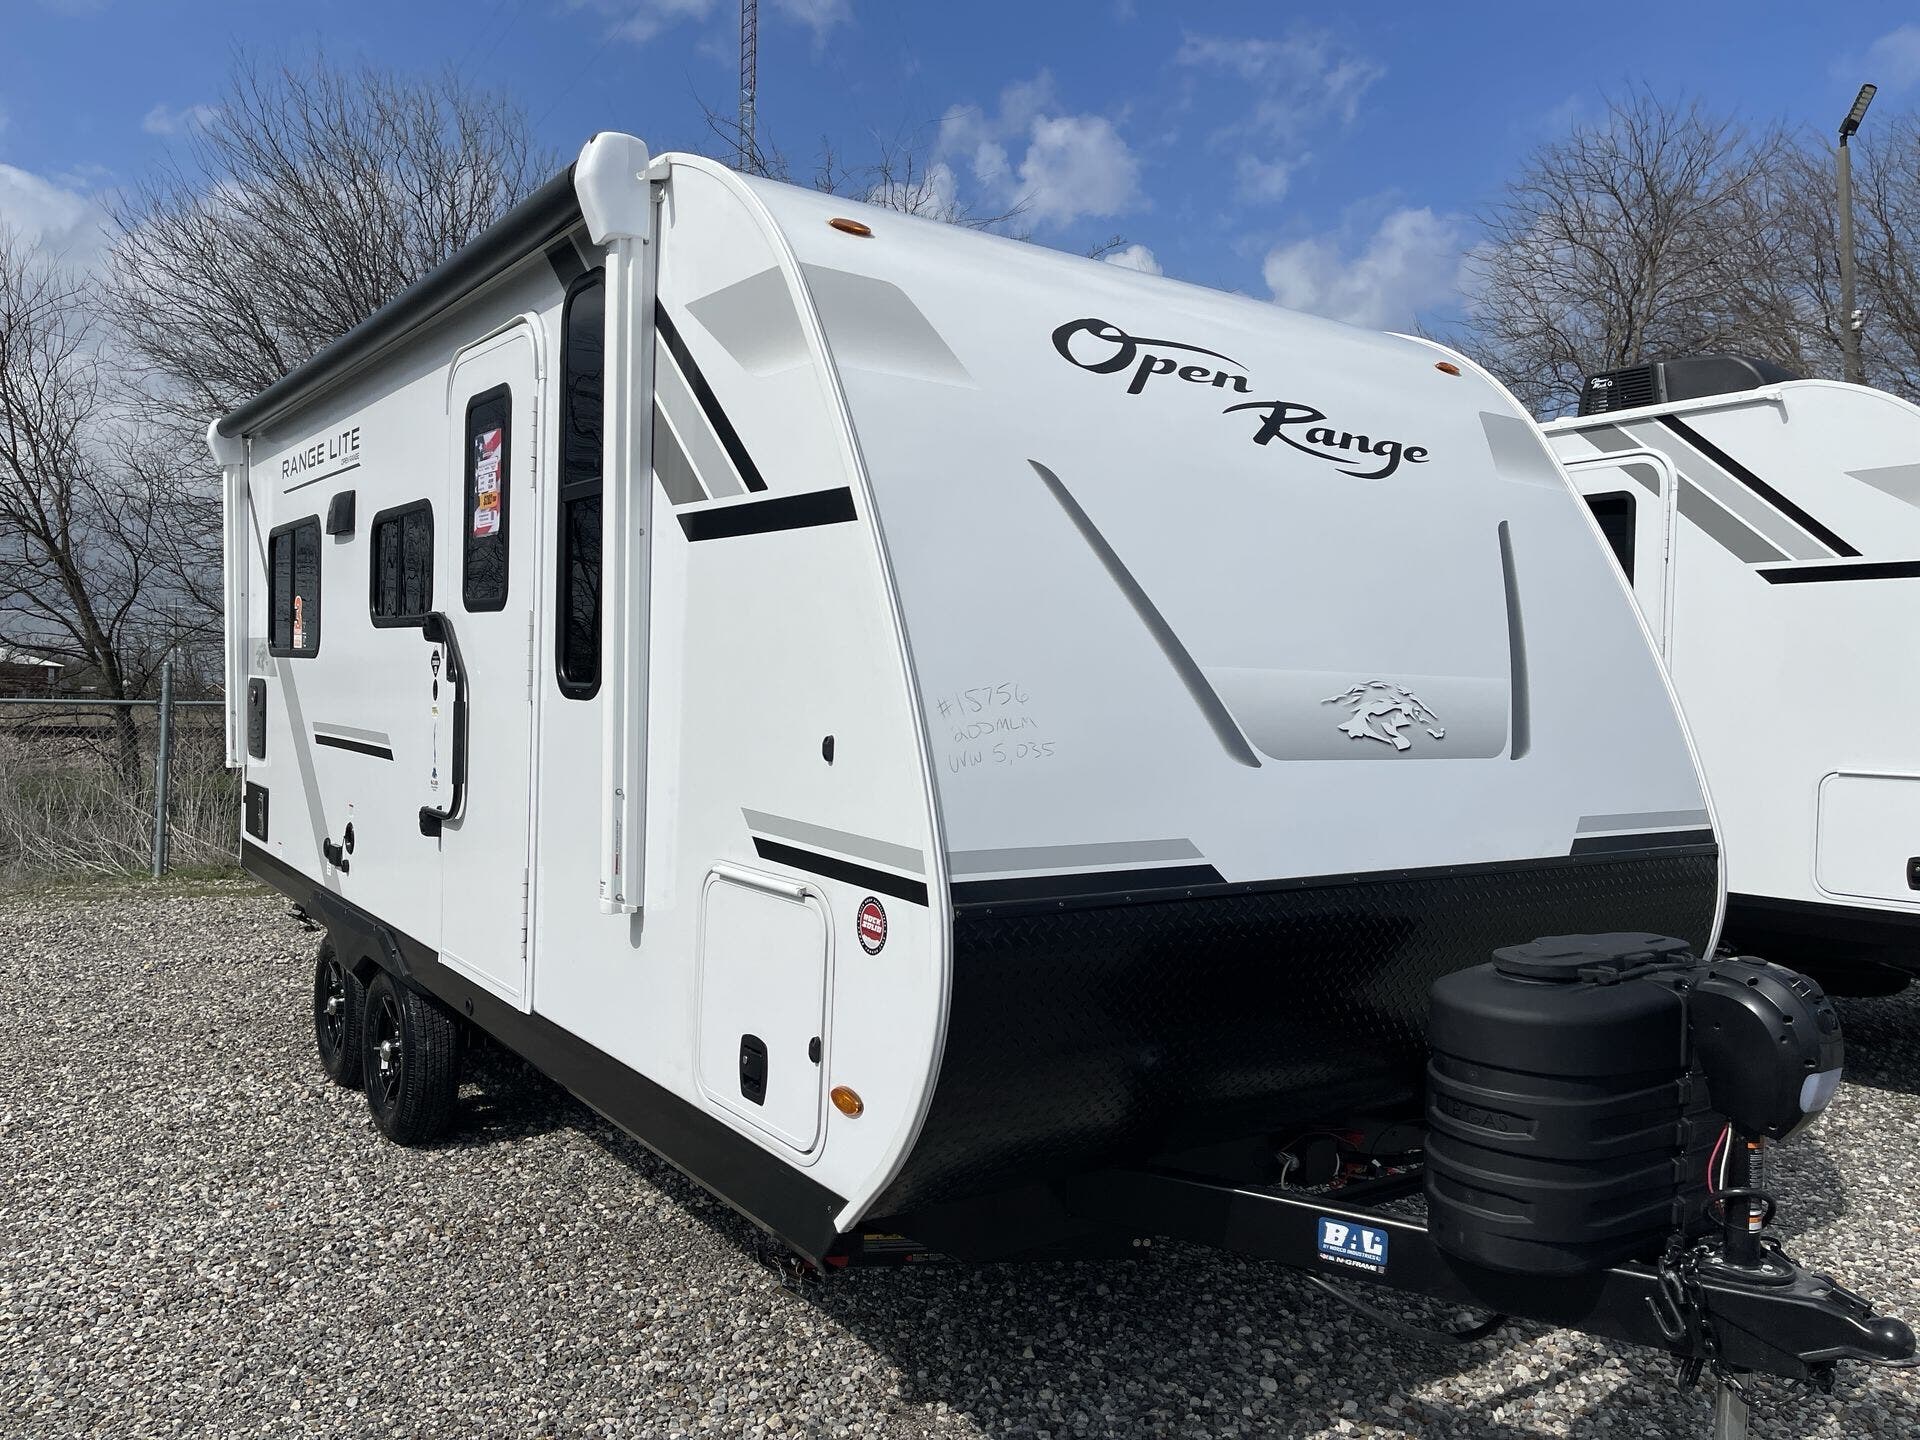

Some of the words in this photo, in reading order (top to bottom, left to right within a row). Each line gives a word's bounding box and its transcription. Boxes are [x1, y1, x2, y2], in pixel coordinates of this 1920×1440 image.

[1052, 318, 1253, 395] Open
[281, 443, 325, 480] RANGE
[329, 427, 361, 460] LITE
[1222, 400, 1431, 480] Range
[937, 682, 1030, 720] #15756
[992, 741, 1056, 767] 5,035
[862, 921, 882, 934] SOLID
[863, 914, 882, 926] ROCK
[1323, 1222, 1383, 1256] BAL
[1352, 1260, 1377, 1271] FRAME
